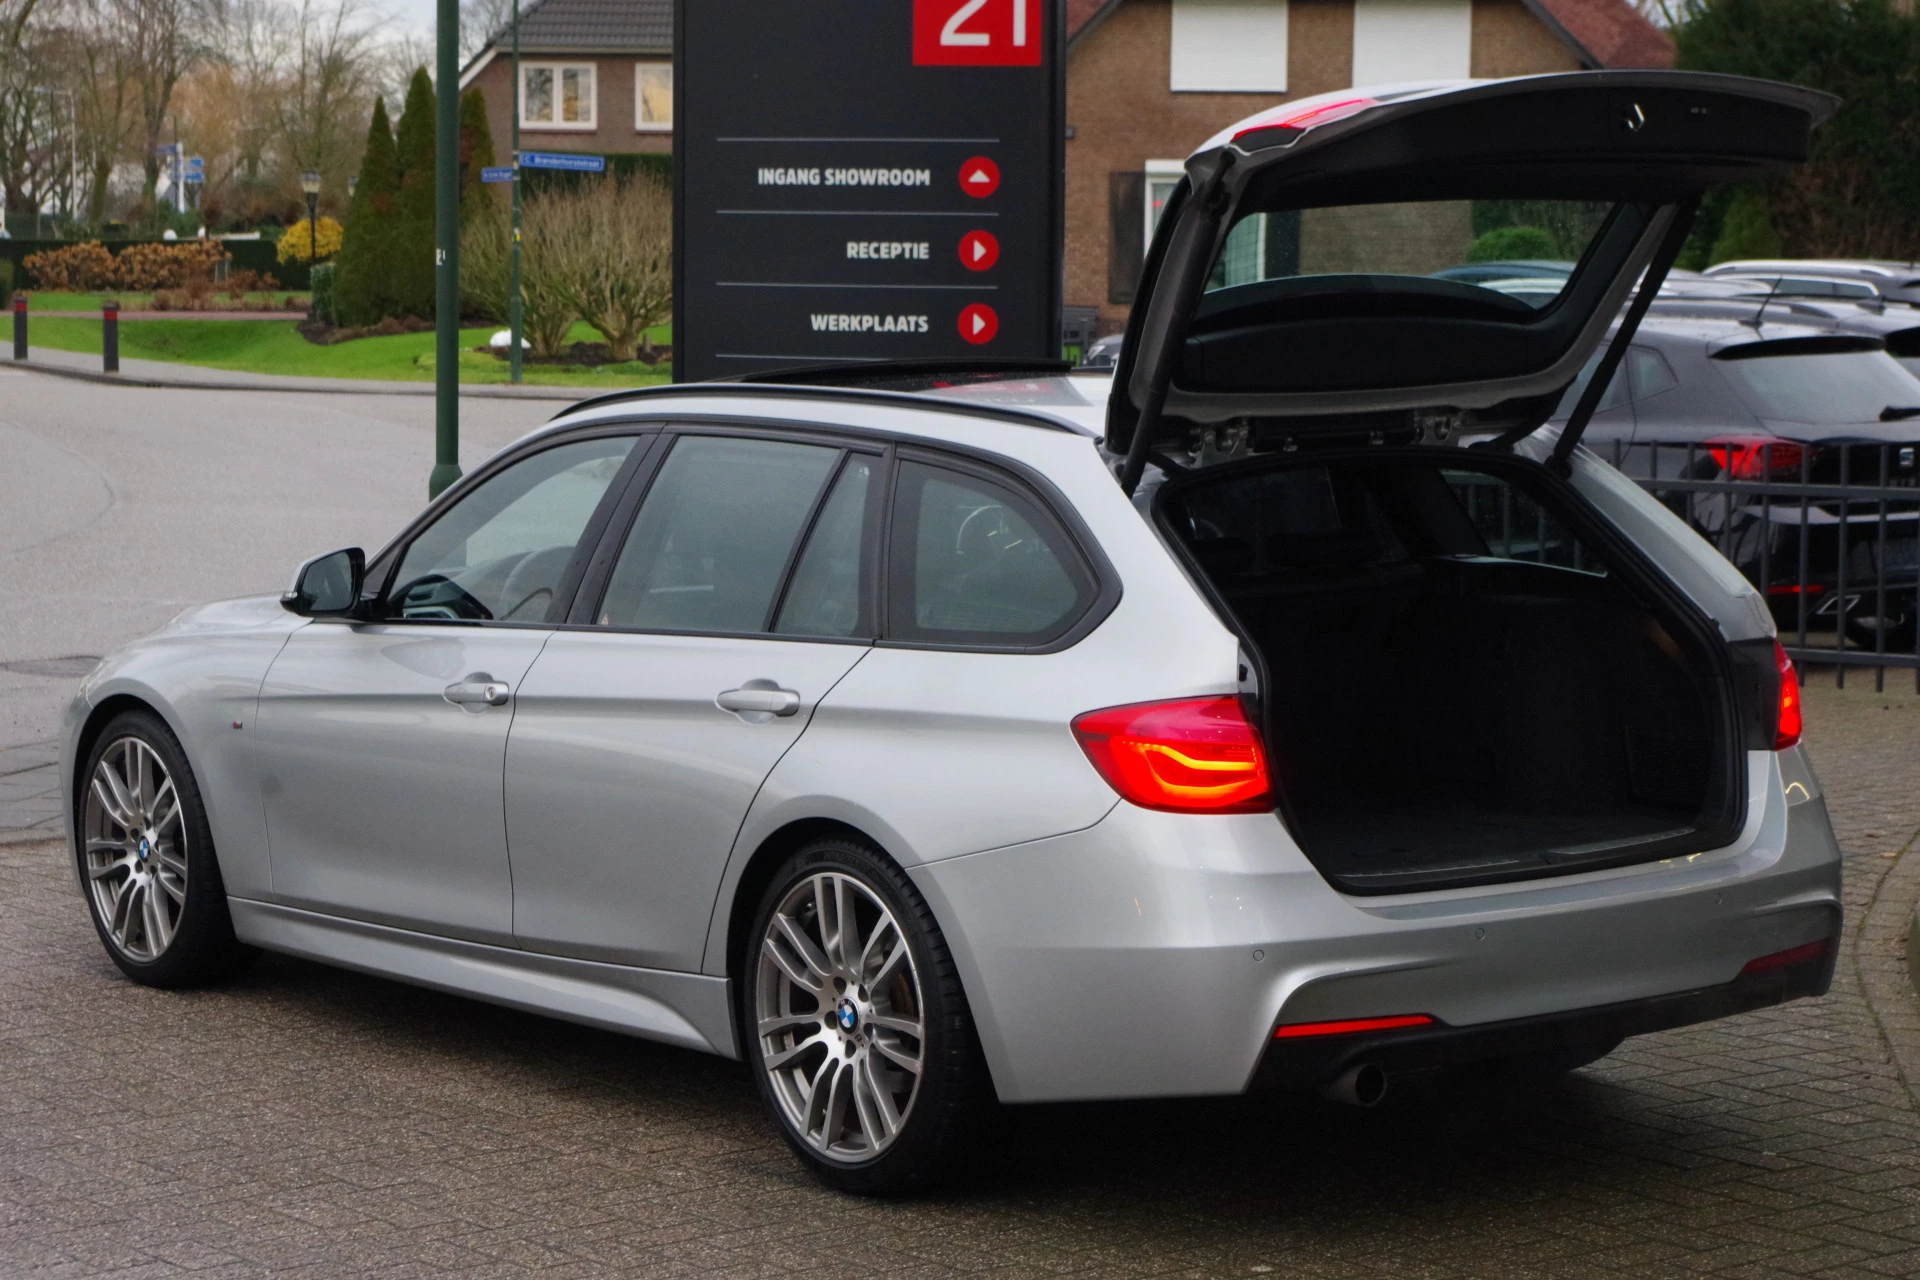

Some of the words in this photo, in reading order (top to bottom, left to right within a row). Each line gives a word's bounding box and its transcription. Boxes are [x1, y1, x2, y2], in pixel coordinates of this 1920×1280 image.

[939, 0, 1027, 47] 21
[757, 167, 821, 186] INGANG
[824, 168, 931, 186] SHOWROOM
[846, 241, 930, 260] RECEPTIE
[810, 313, 929, 333] WERKPLAATS
